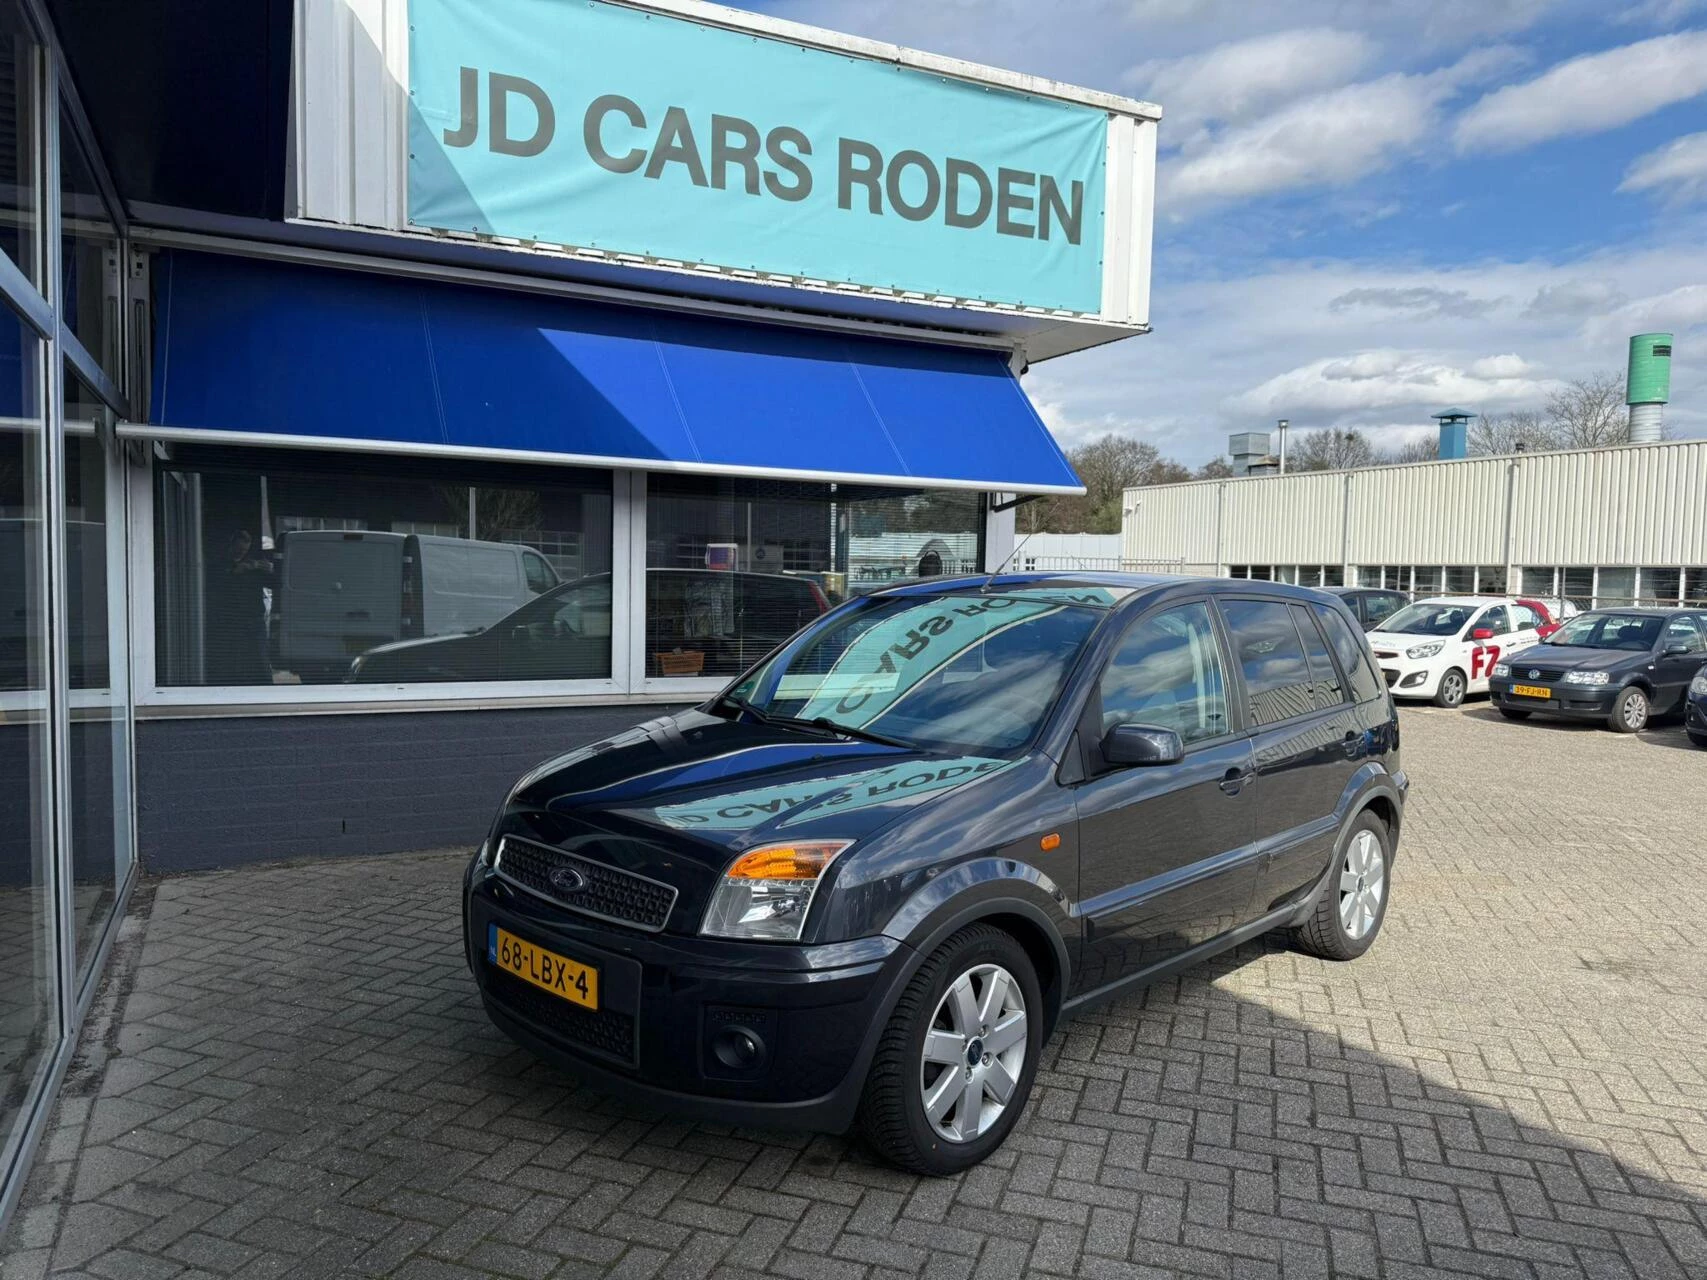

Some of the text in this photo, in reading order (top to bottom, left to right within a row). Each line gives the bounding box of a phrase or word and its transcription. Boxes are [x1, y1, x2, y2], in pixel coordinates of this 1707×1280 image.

[444, 66, 1083, 245] JD CARS RODEN
[1471, 645, 1501, 680] F7
[501, 937, 589, 1000] 68-LBX-4
